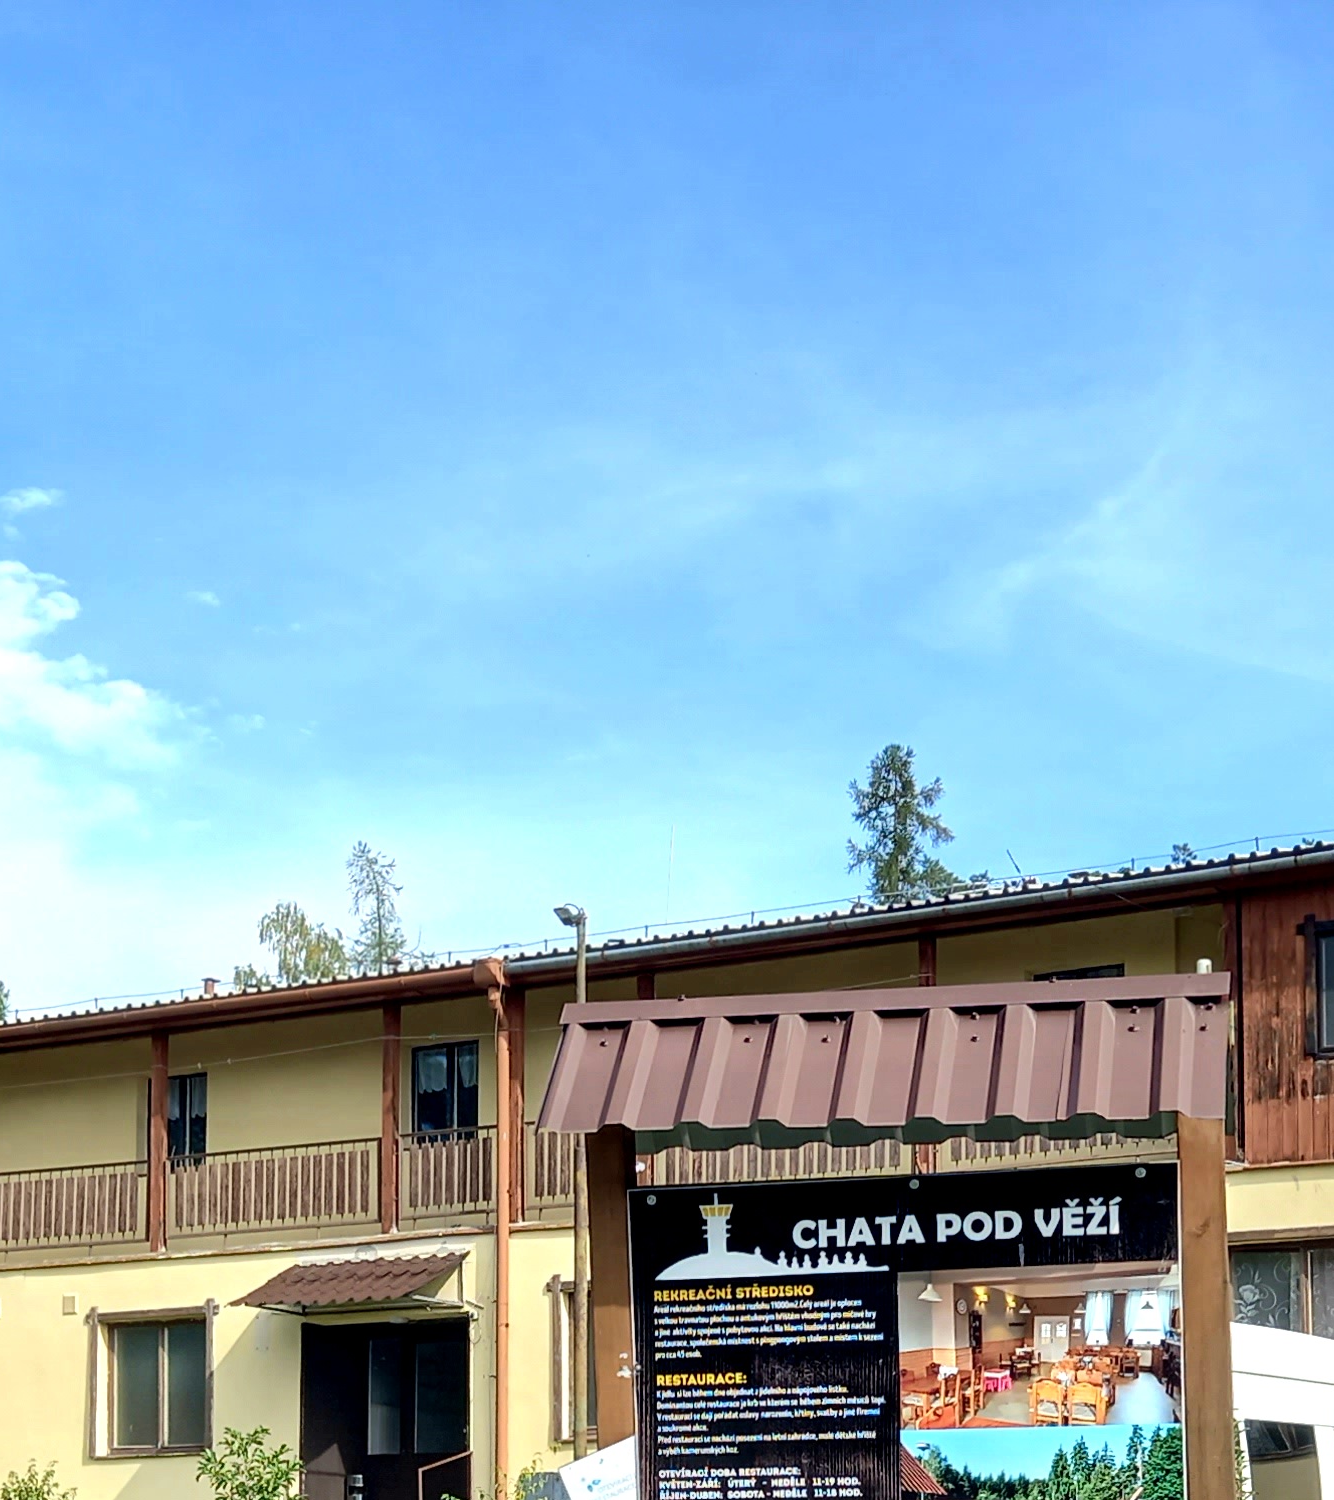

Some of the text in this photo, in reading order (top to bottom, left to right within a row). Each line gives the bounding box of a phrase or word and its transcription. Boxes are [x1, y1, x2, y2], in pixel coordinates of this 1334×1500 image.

[793, 1196, 1121, 1249] CHATA POD VĚŽÍ
[654, 1283, 813, 1301] REKREAČNÍ STŘEDISKO
[657, 1372, 747, 1386] RESTAURACE:
